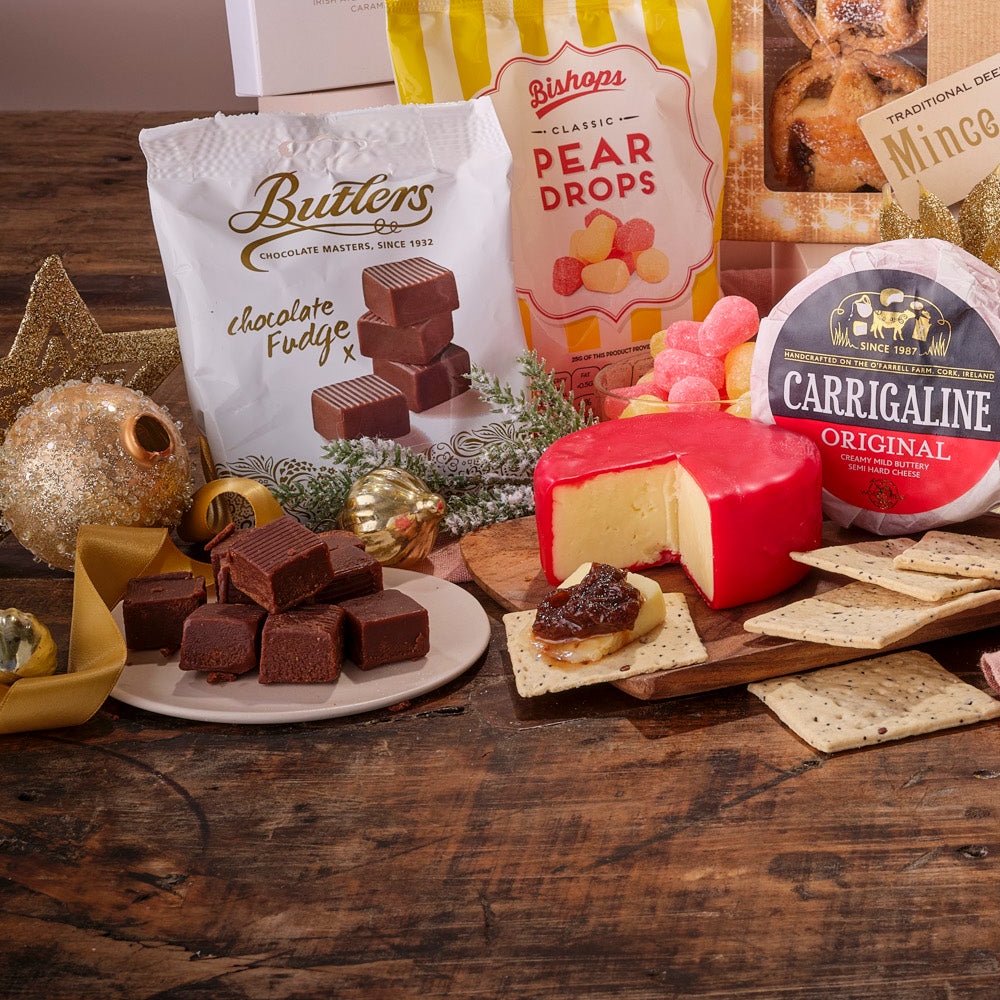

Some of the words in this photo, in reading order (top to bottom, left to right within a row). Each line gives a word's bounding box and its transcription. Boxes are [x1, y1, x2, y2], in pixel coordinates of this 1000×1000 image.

[529, 68, 627, 109] Bishops
[885, 83, 972, 125] TRADITIONAL
[552, 116, 614, 135] CLASSIC
[880, 108, 1000, 180] Mince
[533, 132, 653, 179] PEAR
[228, 170, 434, 234] Butlers
[539, 170, 656, 211] DROPS
[259, 245, 319, 260] CHOCOLATE
[322, 242, 374, 253] MASTERS,
[377, 239, 406, 249] SINCE
[409, 238, 434, 247] 1932
[227, 297, 335, 336] chocolate
[267, 317, 351, 367] Fudge
[606, 348, 632, 357] PRODUCT
[860, 341, 890, 354] SINCE
[893, 345, 918, 356] 1987
[784, 350, 837, 365] HANDCRAFTED
[839, 357, 851, 365] ON
[854, 359, 869, 368] THE
[870, 362, 909, 372] O'FARRELL
[962, 370, 995, 380] IRELAND
[783, 370, 992, 432] CARRIGALINE
[821, 427, 951, 461] ORIGINAL
[840, 453, 872, 464] CREAMY
[873, 458, 892, 467] MILD
[894, 460, 930, 471] BUTTERY
[848, 463, 866, 472] SEMI
[867, 466, 890, 475] HARD
[892, 469, 920, 479] CHEESE
